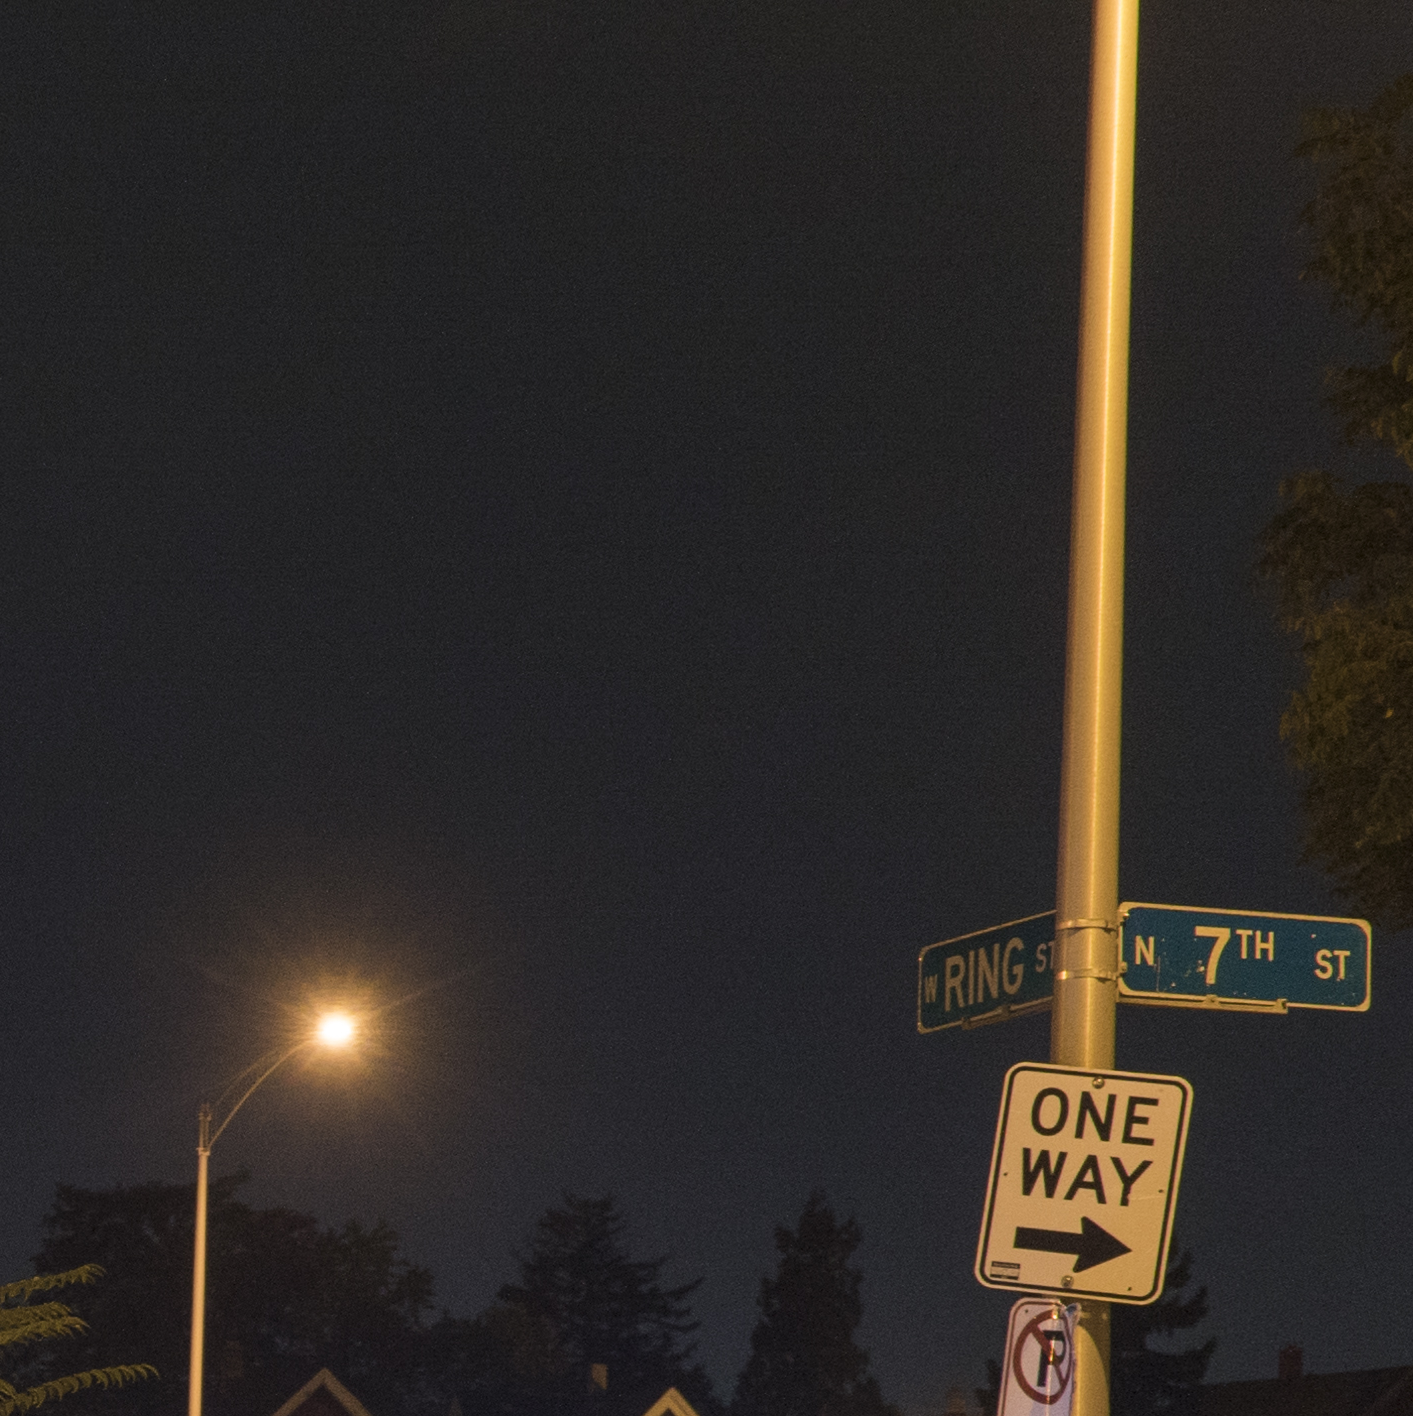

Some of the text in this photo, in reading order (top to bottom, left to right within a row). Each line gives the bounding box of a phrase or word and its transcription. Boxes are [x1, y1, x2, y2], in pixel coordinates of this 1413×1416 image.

[924, 974, 938, 1003] W
[944, 937, 1025, 1012] RING
[1134, 925, 1351, 985] N 7TH ST
[1030, 1087, 1160, 1147] ONE
[1021, 1147, 1154, 1207] WAY
